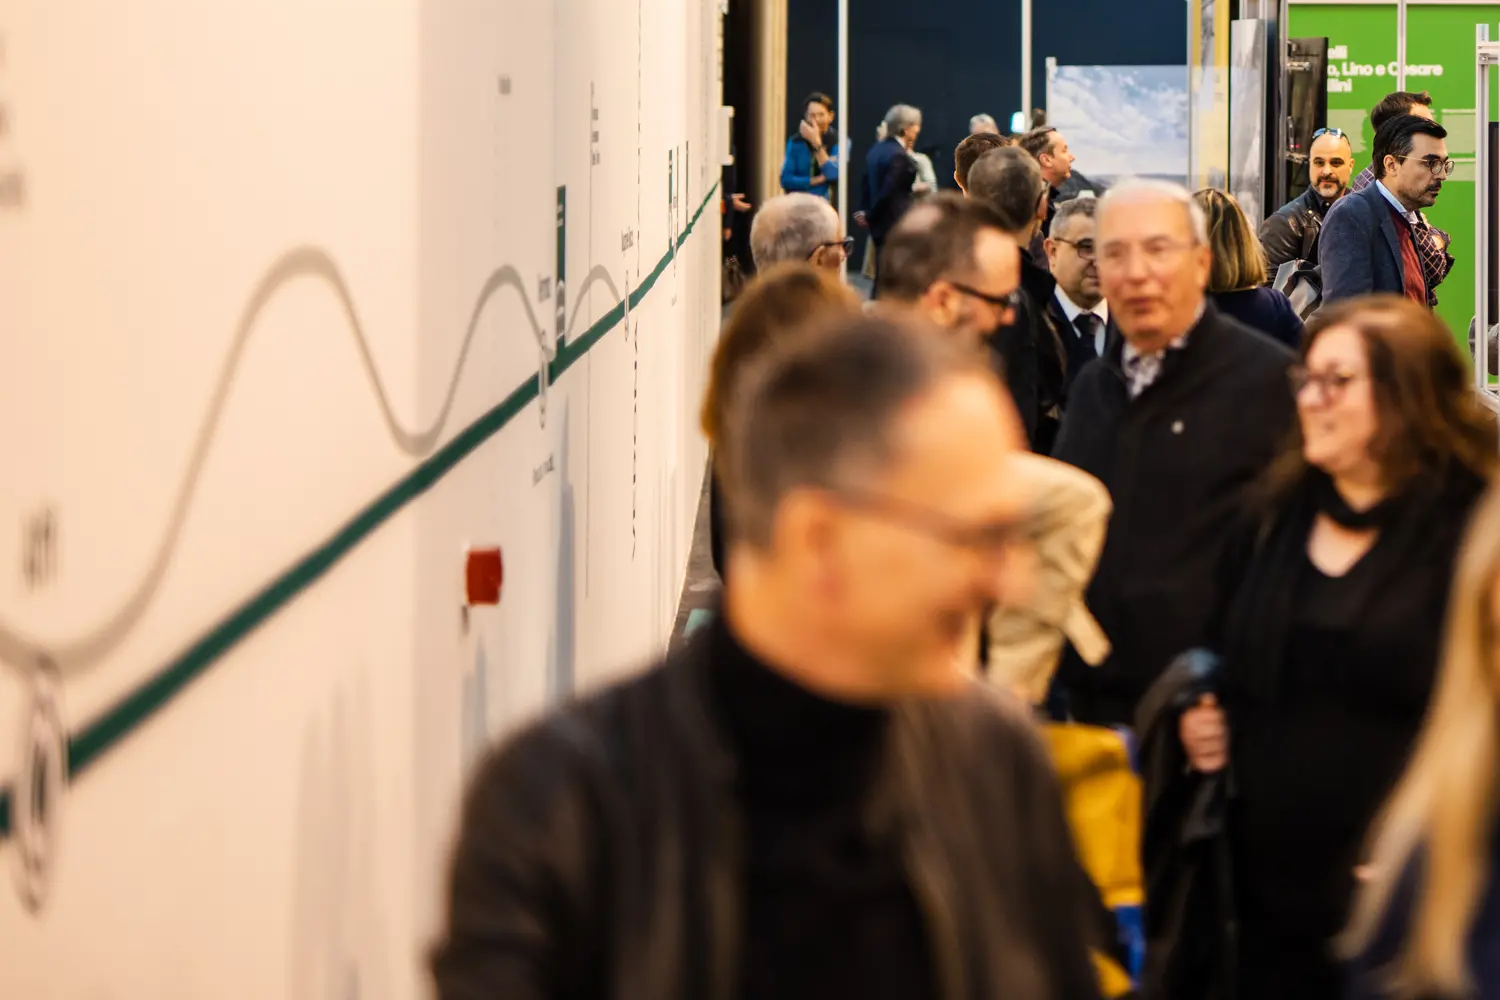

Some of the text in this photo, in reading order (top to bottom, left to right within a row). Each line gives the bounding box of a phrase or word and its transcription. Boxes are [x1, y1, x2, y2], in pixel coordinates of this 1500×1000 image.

[1342, 61, 1373, 76] Lino
[1375, 64, 1386, 76] e
[1388, 61, 1443, 76] Csare
